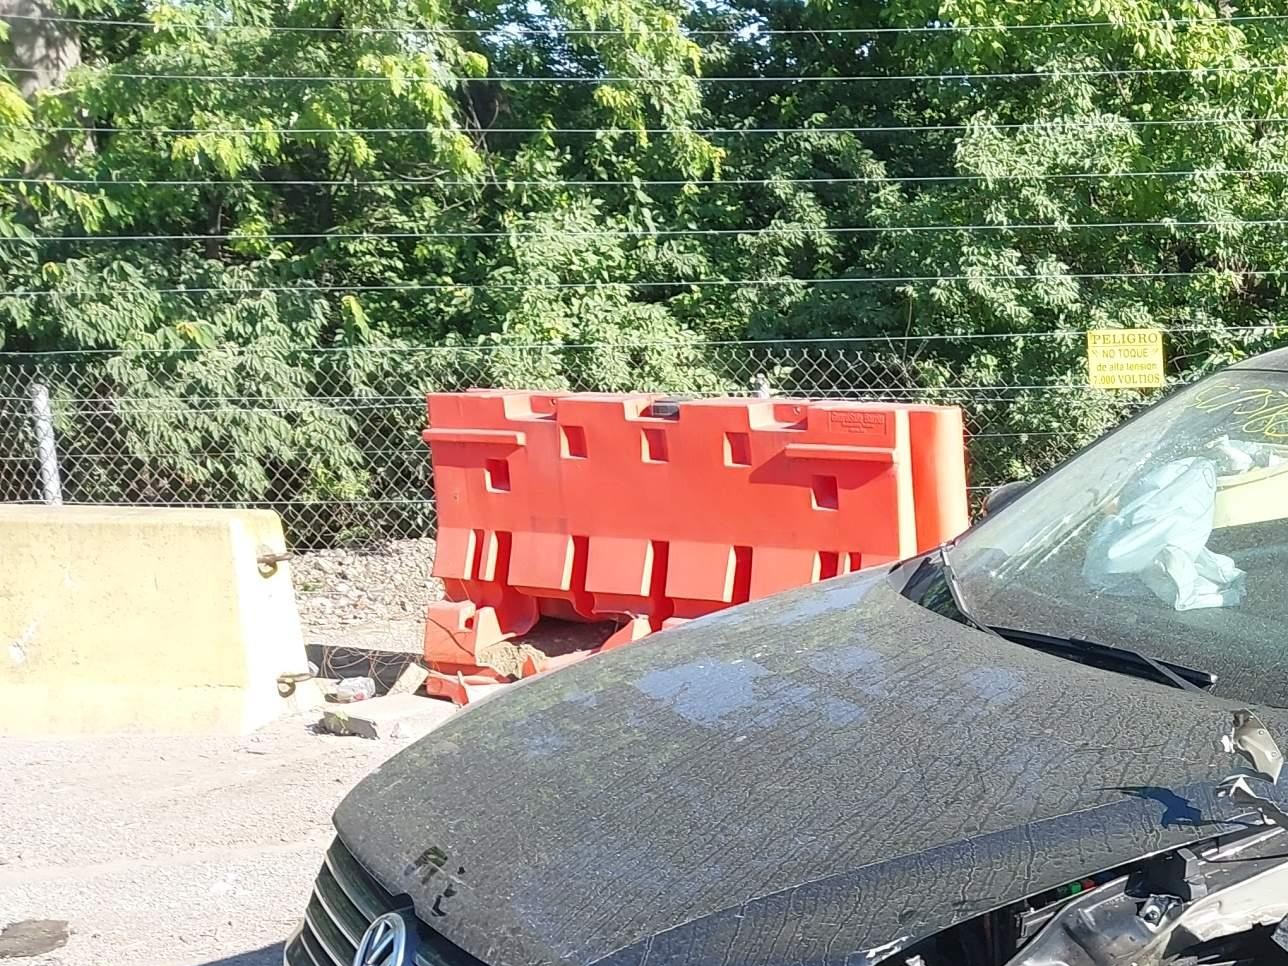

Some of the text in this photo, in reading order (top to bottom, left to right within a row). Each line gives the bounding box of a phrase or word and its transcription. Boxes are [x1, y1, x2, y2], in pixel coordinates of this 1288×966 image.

[1091, 333, 1158, 344] PELIGRO
[1102, 348, 1148, 358] NO TOQUE
[1096, 363, 1107, 371] de
[1109, 362, 1124, 371] alta
[1118, 373, 1160, 384] VOLTIOS
